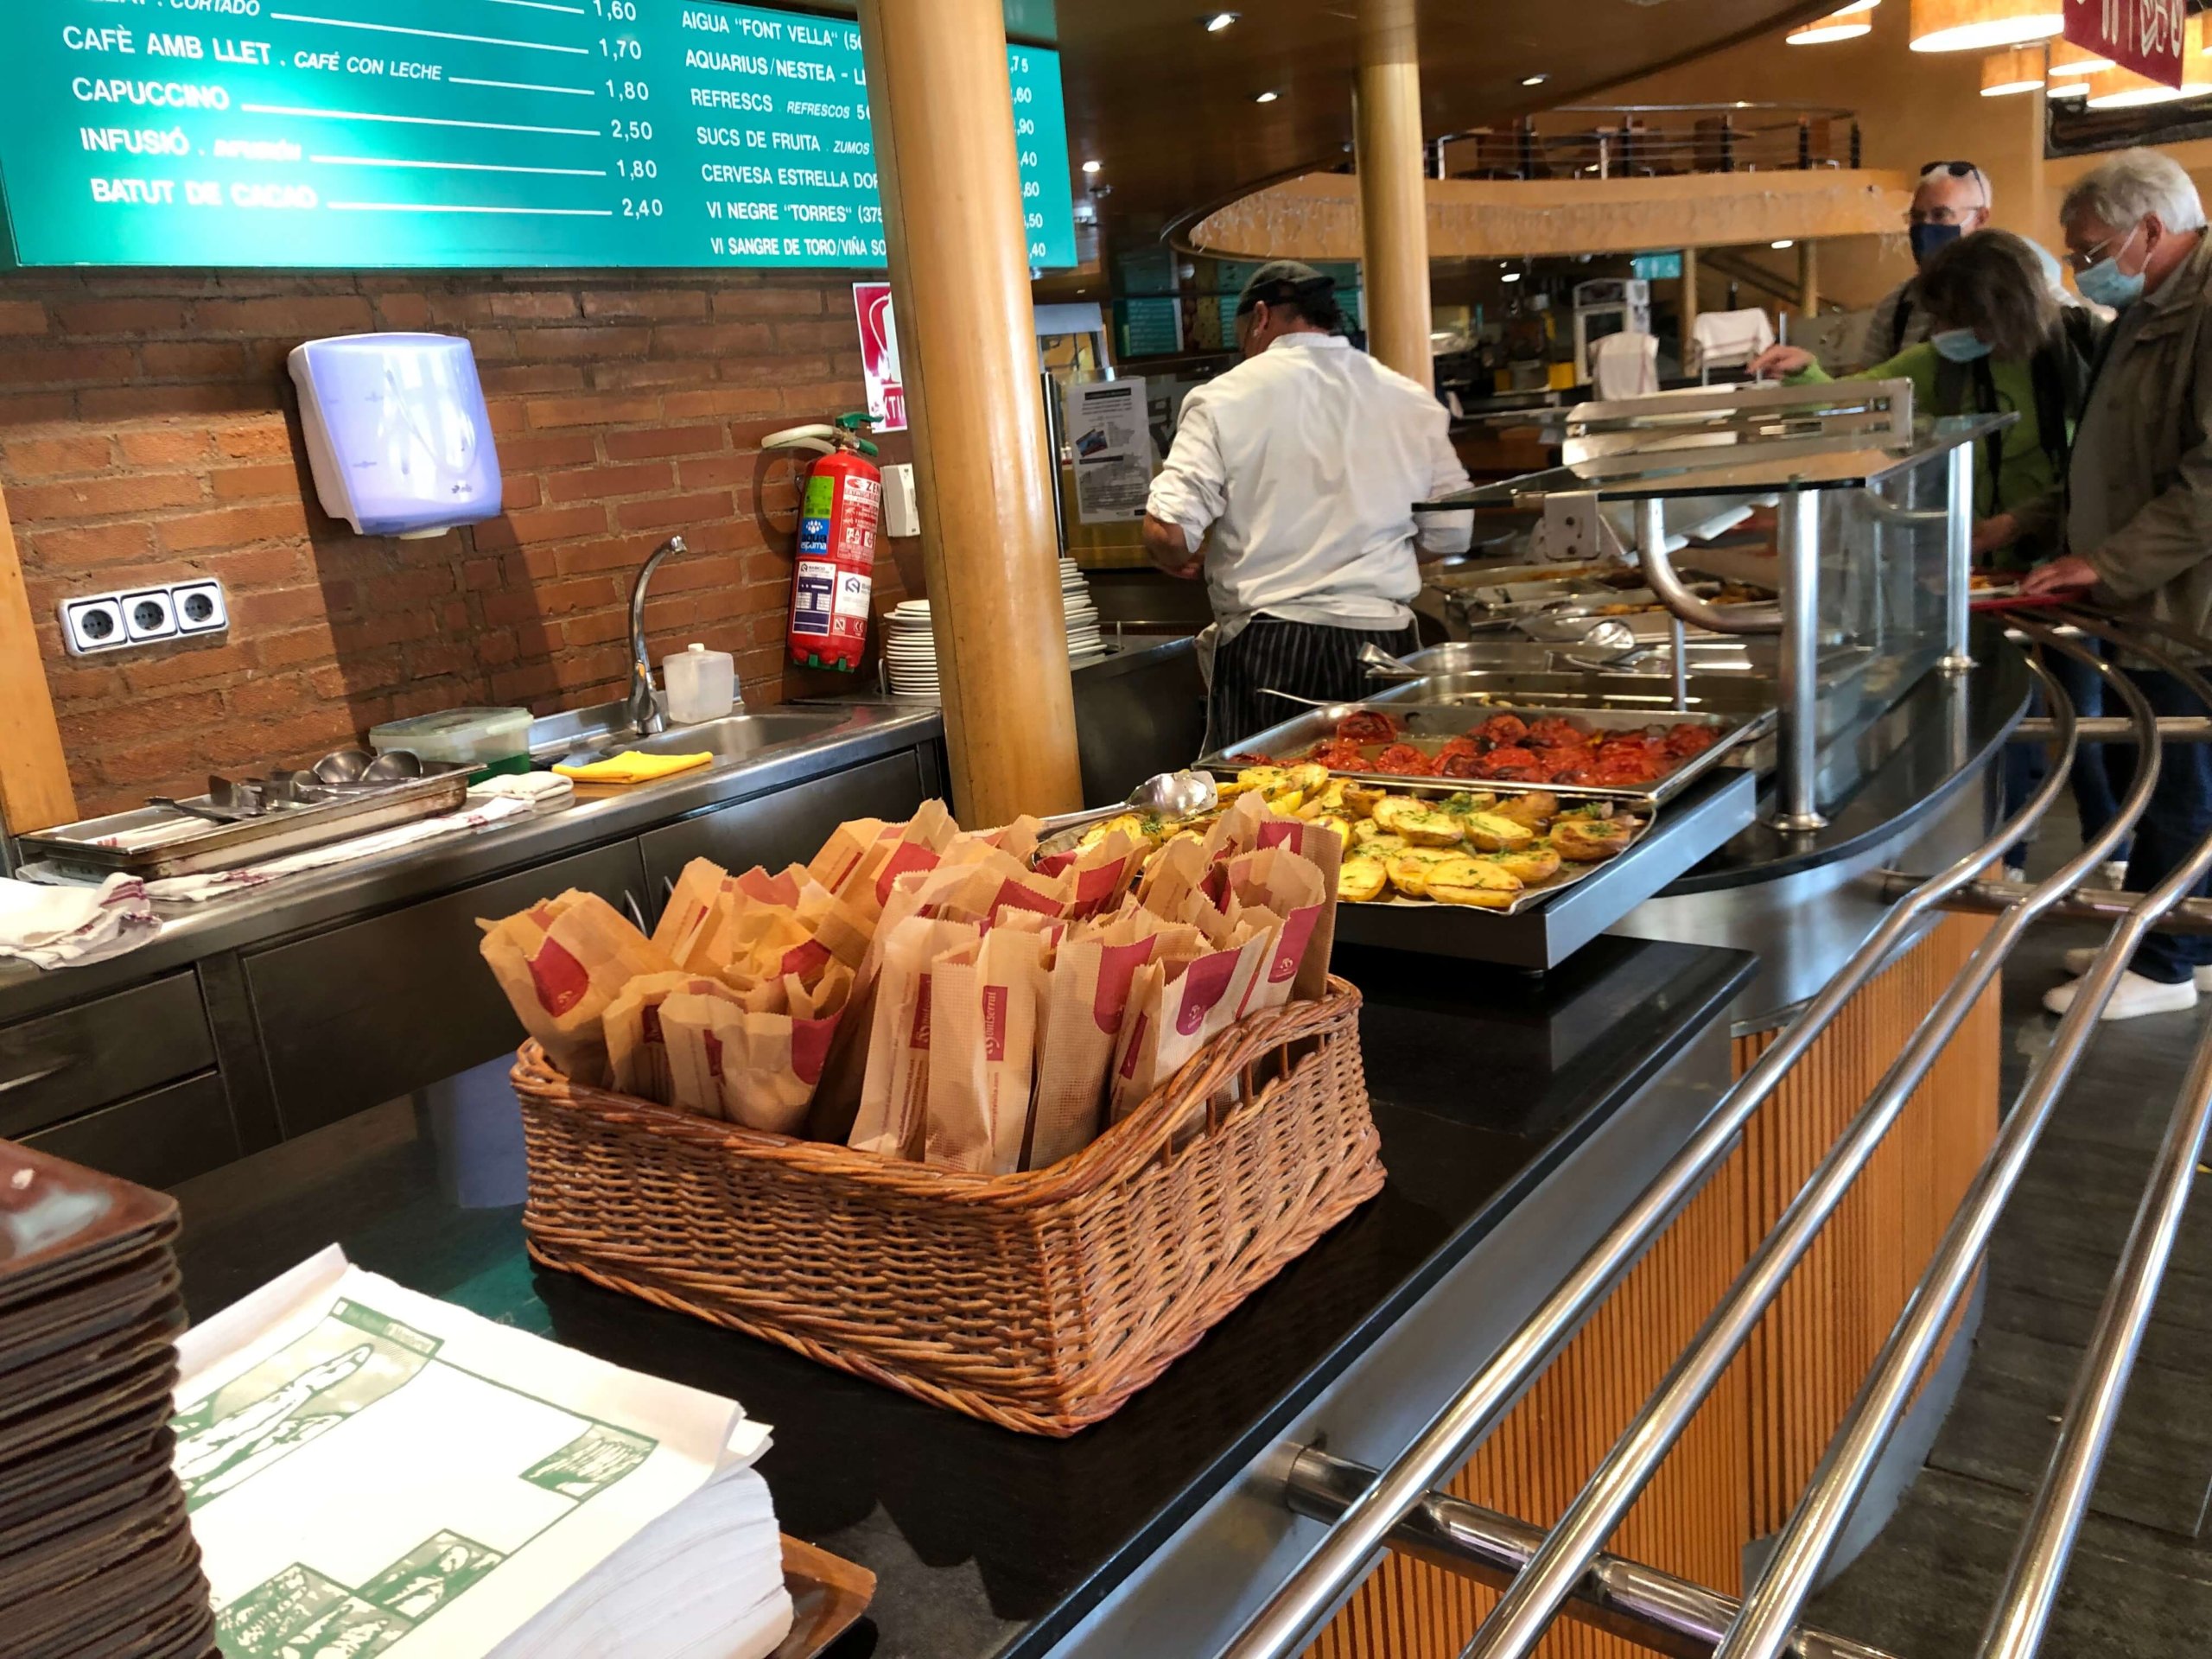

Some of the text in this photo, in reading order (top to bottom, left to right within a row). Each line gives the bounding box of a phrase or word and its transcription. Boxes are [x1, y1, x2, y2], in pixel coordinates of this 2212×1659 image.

[593, 0, 637, 21] 1,60
[682, 10, 730, 33] AIGUA
[62, 24, 442, 81] CAFÈ AMB LLET CAFÉ CON LECHE
[599, 38, 642, 61] 1,70
[685, 49, 836, 83] AQUARIUS/NESTEA
[1009, 55, 1029, 74] ,75
[72, 77, 230, 110] CAPUCCINO
[606, 79, 649, 102] 1,80
[1010, 86, 1033, 105] ,60
[690, 88, 773, 112] REFRESCS
[787, 100, 850, 119] REFRESCOS
[611, 119, 652, 143] 2,50
[1014, 118, 1034, 137] ,90
[79, 126, 190, 156] INFUSIÓ
[696, 126, 870, 156] SUCS DE FRUITA ZUMOS
[616, 159, 658, 181] 1,80
[1018, 150, 1037, 168] ,40
[702, 164, 773, 184] CERVESA
[779, 168, 849, 188] ESTRELLA
[90, 178, 175, 204] BATUT
[185, 181, 222, 206] DE
[622, 198, 663, 220] 2,40
[706, 201, 722, 219] VI
[727, 202, 779, 221] NEGRE
[1024, 213, 1043, 230] ,50
[710, 238, 724, 255] VI
[728, 238, 780, 256] SANGRE
[784, 238, 801, 256] DE
[804, 236, 868, 257] TORO/VIÑA
[1028, 243, 1046, 260] ,40
